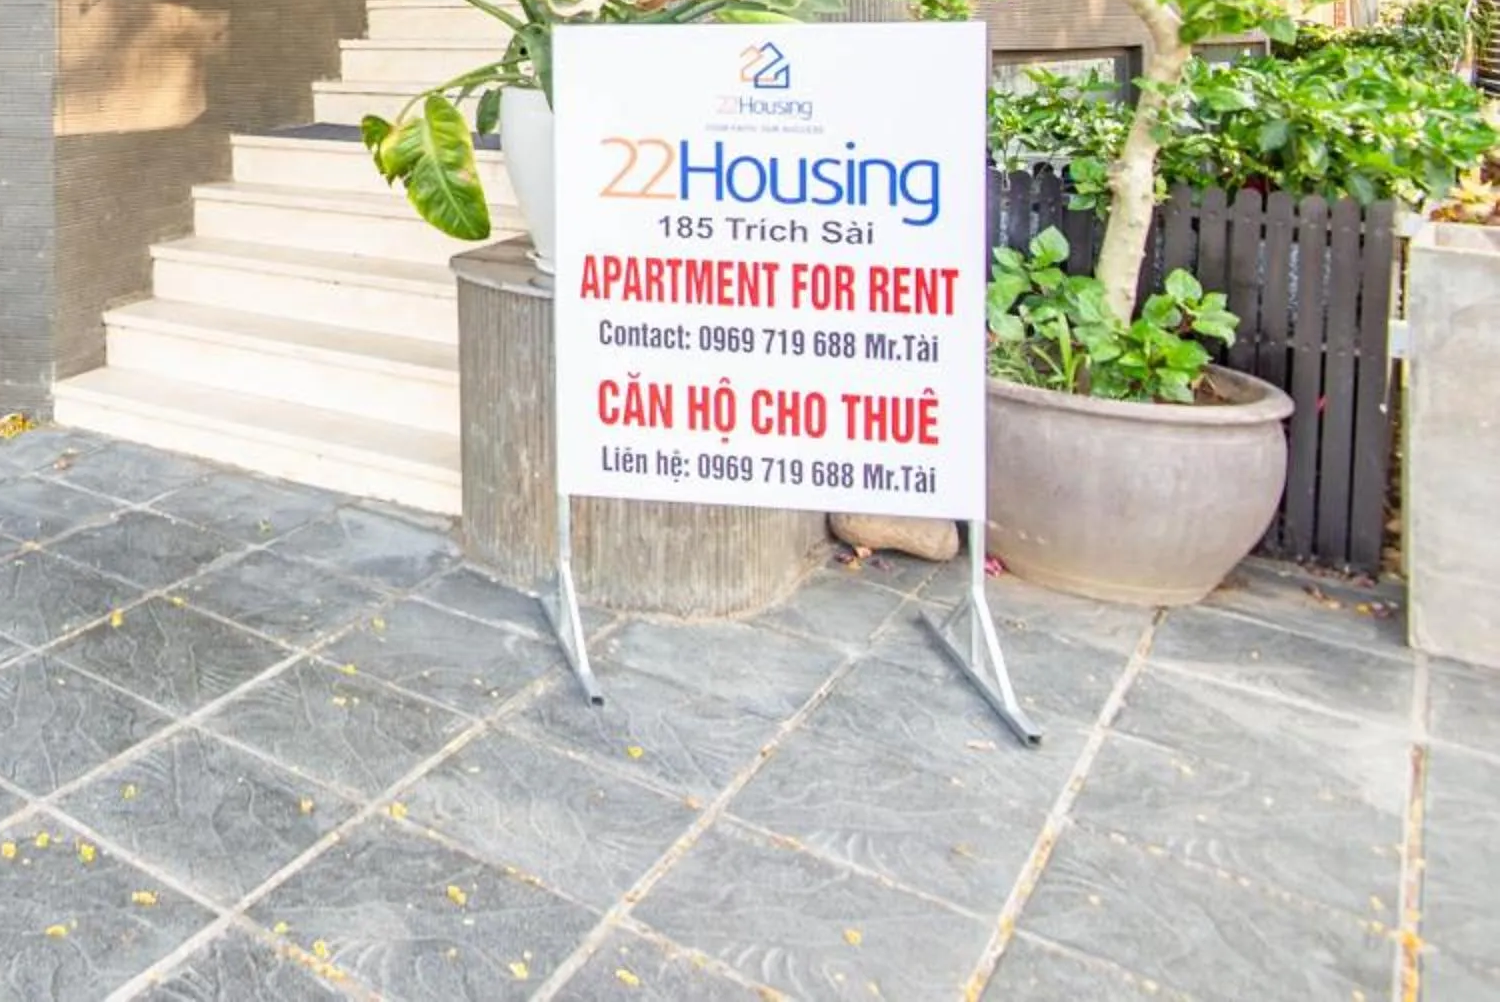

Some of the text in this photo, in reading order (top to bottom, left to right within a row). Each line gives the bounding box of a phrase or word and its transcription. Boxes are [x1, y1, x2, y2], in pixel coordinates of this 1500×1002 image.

[599, 136, 940, 226] 22Housing
[658, 215, 875, 246] 185 Trích Sài
[580, 254, 960, 316] APARTMENT FOR RENT
[599, 319, 940, 363] Contact: 0969 719 688 Mr.Tài
[597, 371, 941, 446] CĂN HỘ CHO THUÊ
[601, 445, 937, 495] Liên hệ: 0969 719 688 Mr.Tài
